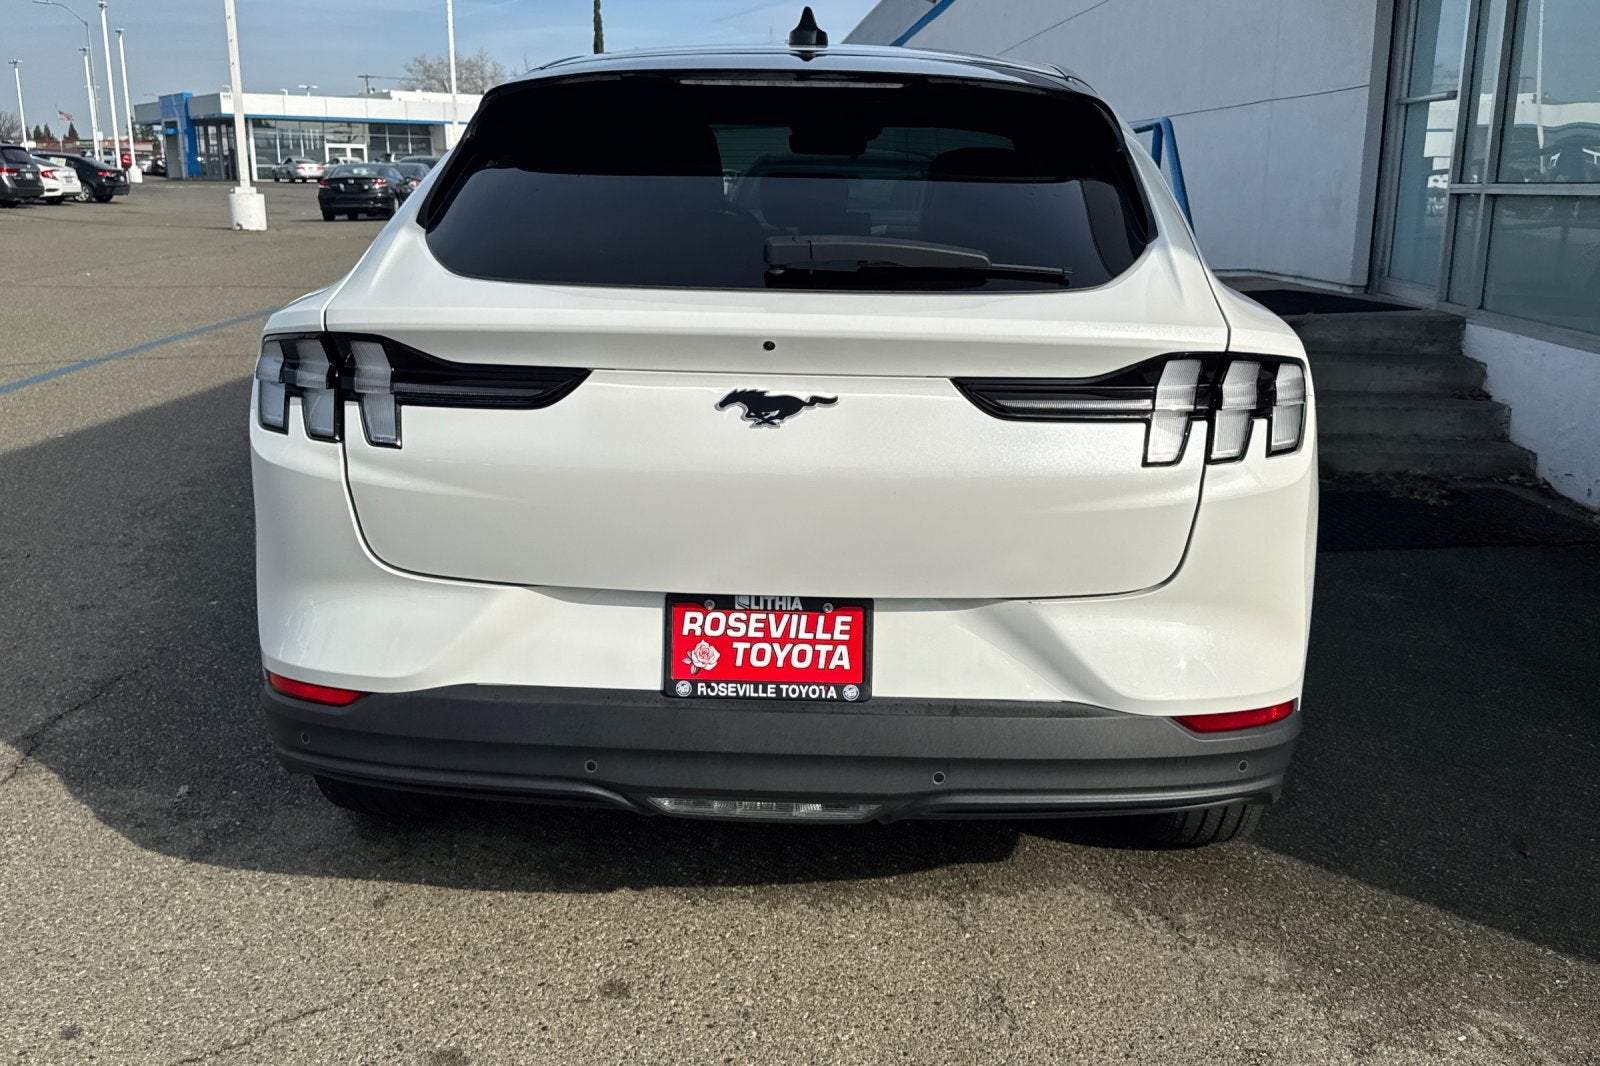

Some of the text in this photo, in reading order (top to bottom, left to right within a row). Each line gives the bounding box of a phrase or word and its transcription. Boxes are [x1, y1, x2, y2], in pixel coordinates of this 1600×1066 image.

[750, 595, 803, 611] LITHIA
[682, 611, 853, 641] ROSEVILLE
[732, 642, 851, 670] TOYOTA
[697, 682, 837, 699] ROSEVILLE TOYOTA
